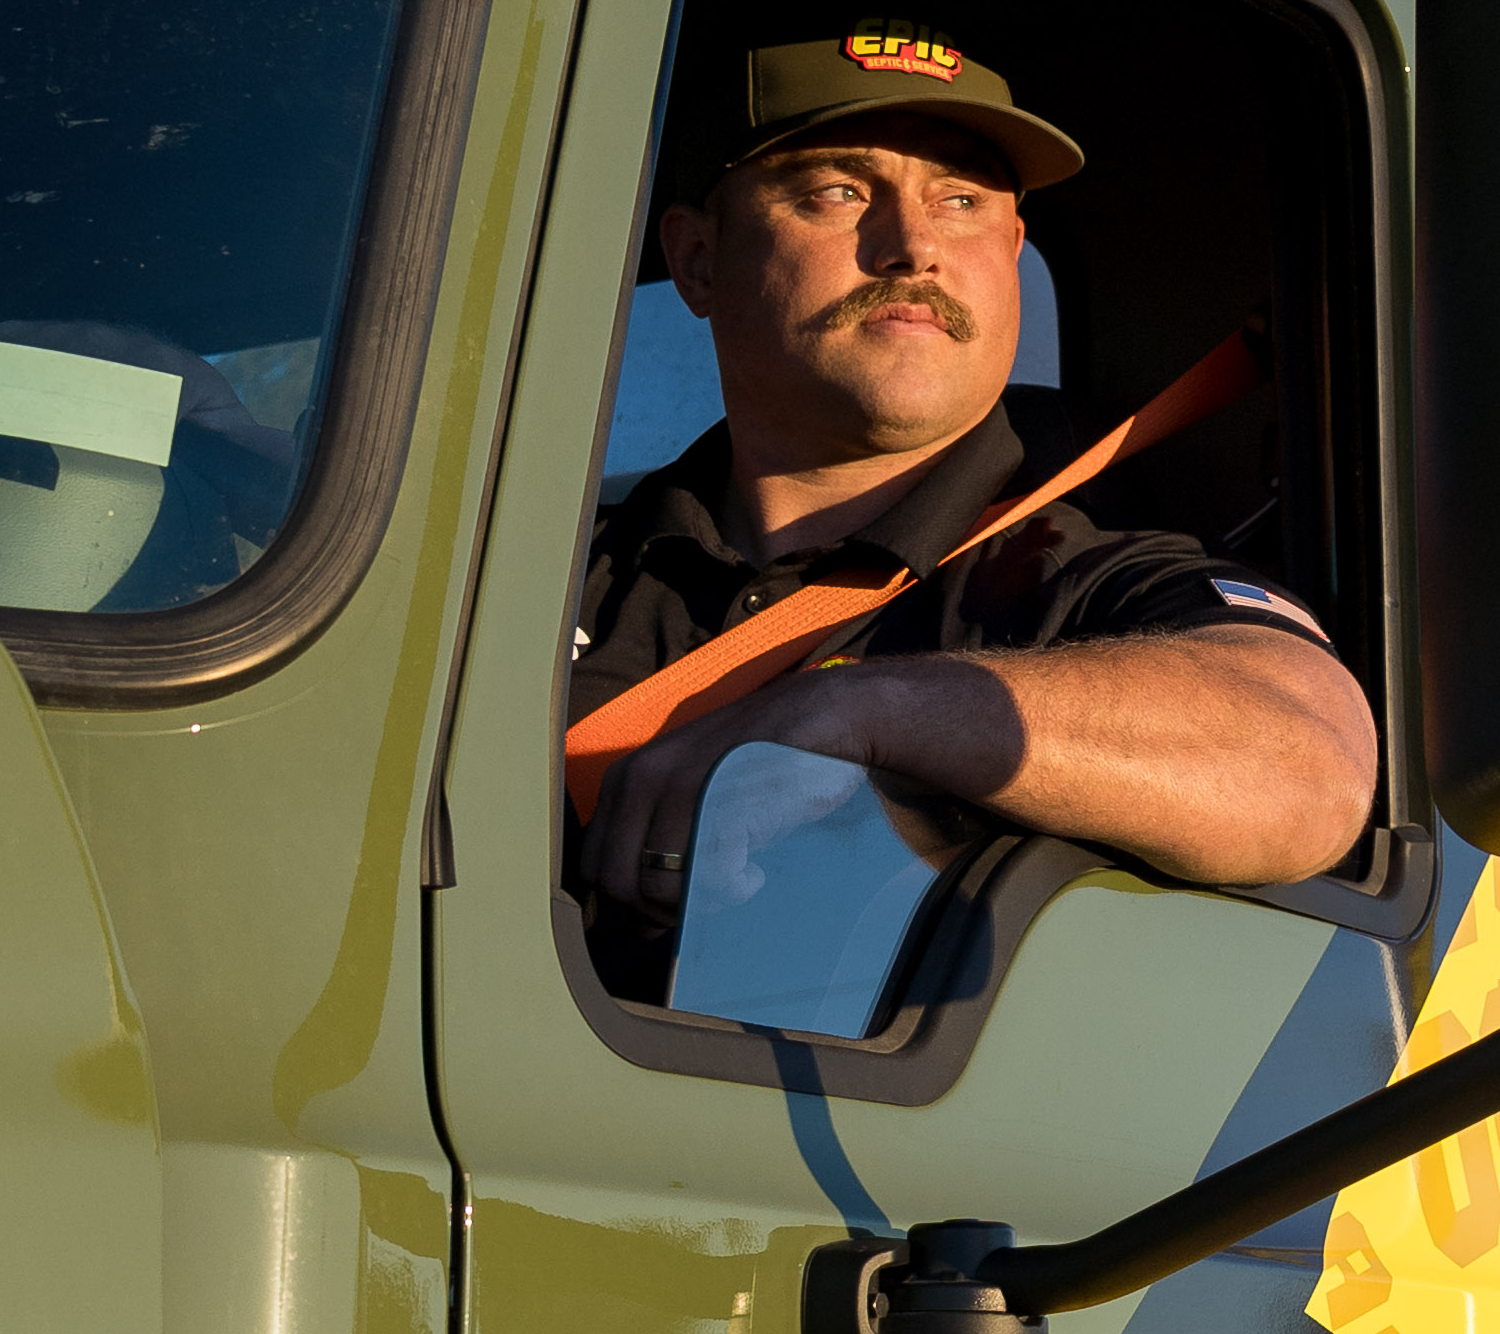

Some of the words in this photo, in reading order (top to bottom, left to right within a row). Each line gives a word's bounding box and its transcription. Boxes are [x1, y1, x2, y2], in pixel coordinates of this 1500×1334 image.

[852, 18, 956, 68] EPIC
[866, 58, 902, 68] SEPTIC
[911, 60, 950, 79] SERVICE
